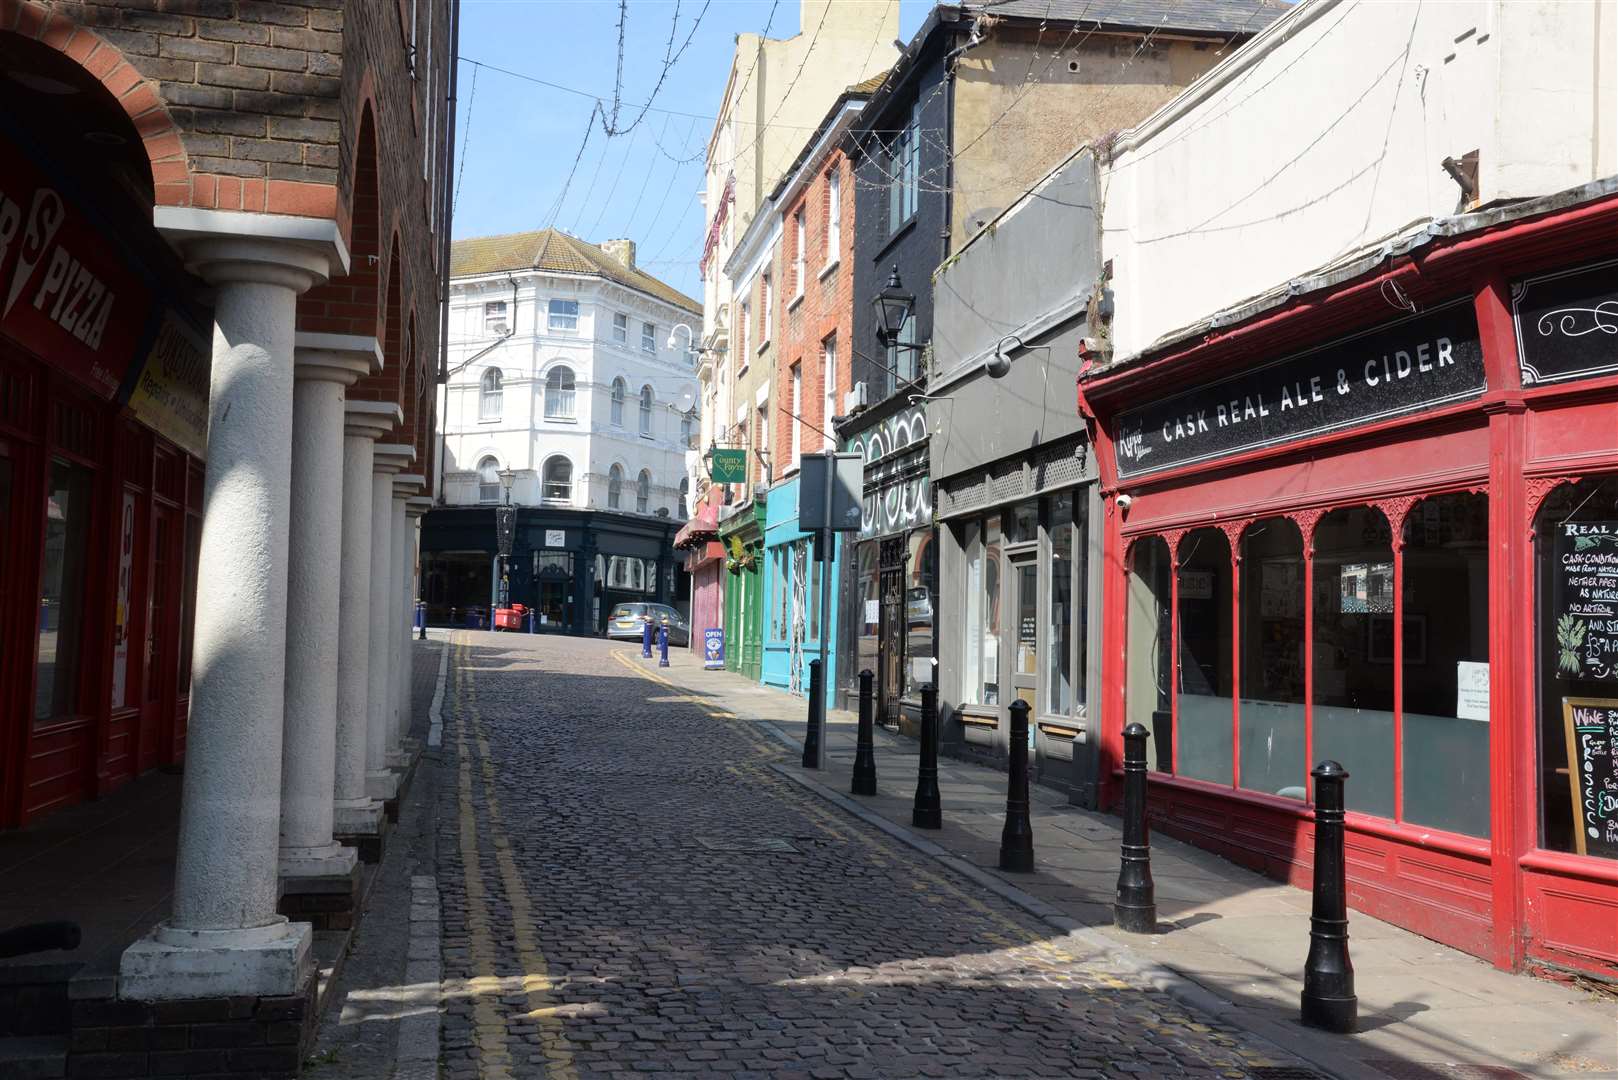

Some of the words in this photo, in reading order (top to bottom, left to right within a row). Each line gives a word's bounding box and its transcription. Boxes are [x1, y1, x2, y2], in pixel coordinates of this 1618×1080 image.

[33, 244, 115, 351] PIZZA
[1162, 409, 1209, 442] CASK
[1217, 394, 1269, 428] REAL
[1281, 376, 1323, 411] ALE
[1336, 369, 1350, 395] &
[1364, 337, 1456, 386] CIDER
[1565, 524, 1610, 536] REAL
[1579, 588, 1590, 598] AS
[1569, 603, 1581, 612] NO
[1588, 619, 1605, 632] AND
